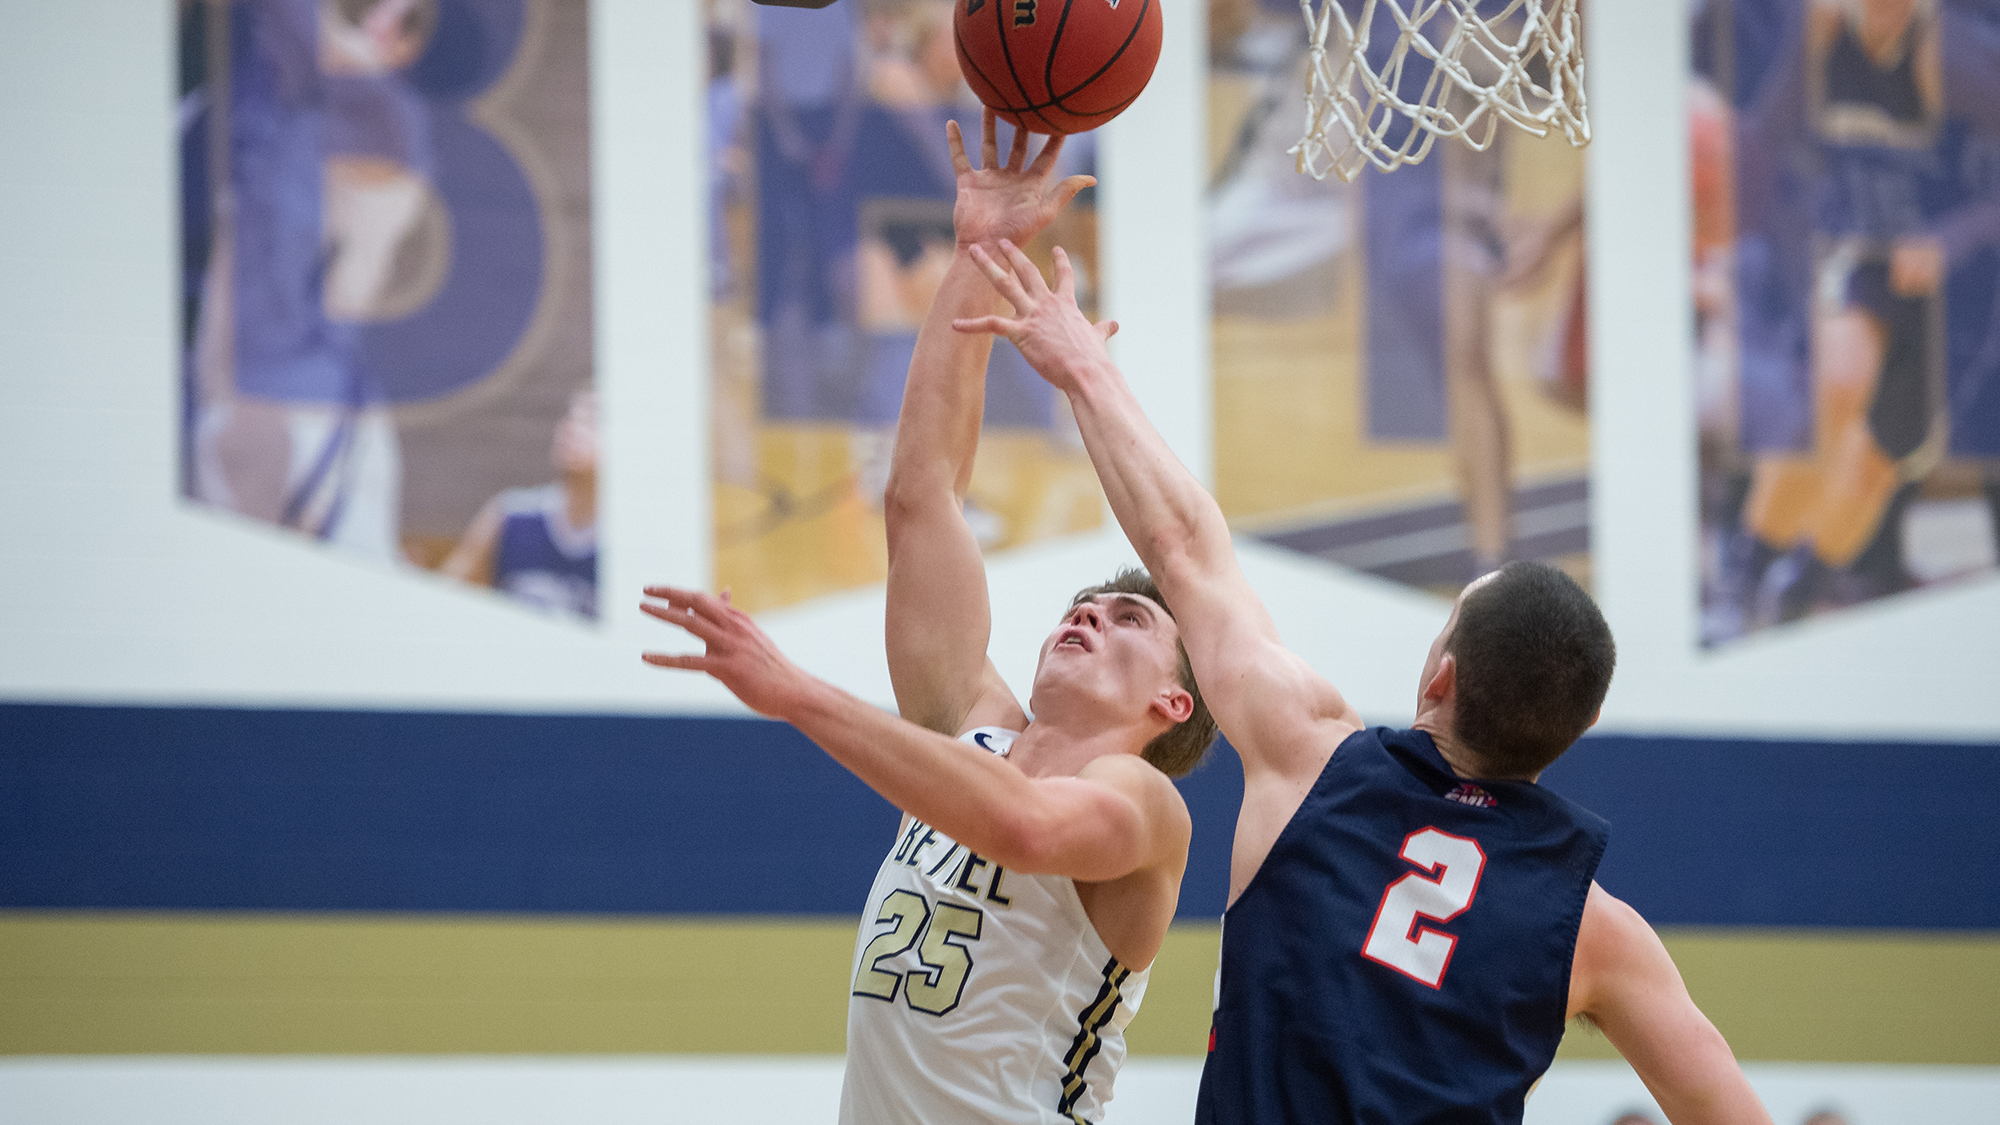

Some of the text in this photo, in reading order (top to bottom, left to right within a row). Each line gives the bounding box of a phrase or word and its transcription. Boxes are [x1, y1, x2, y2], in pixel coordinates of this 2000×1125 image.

[894, 818, 1012, 908] BEEL
[1360, 825, 1488, 990] 2
[852, 887, 984, 1018] 25
